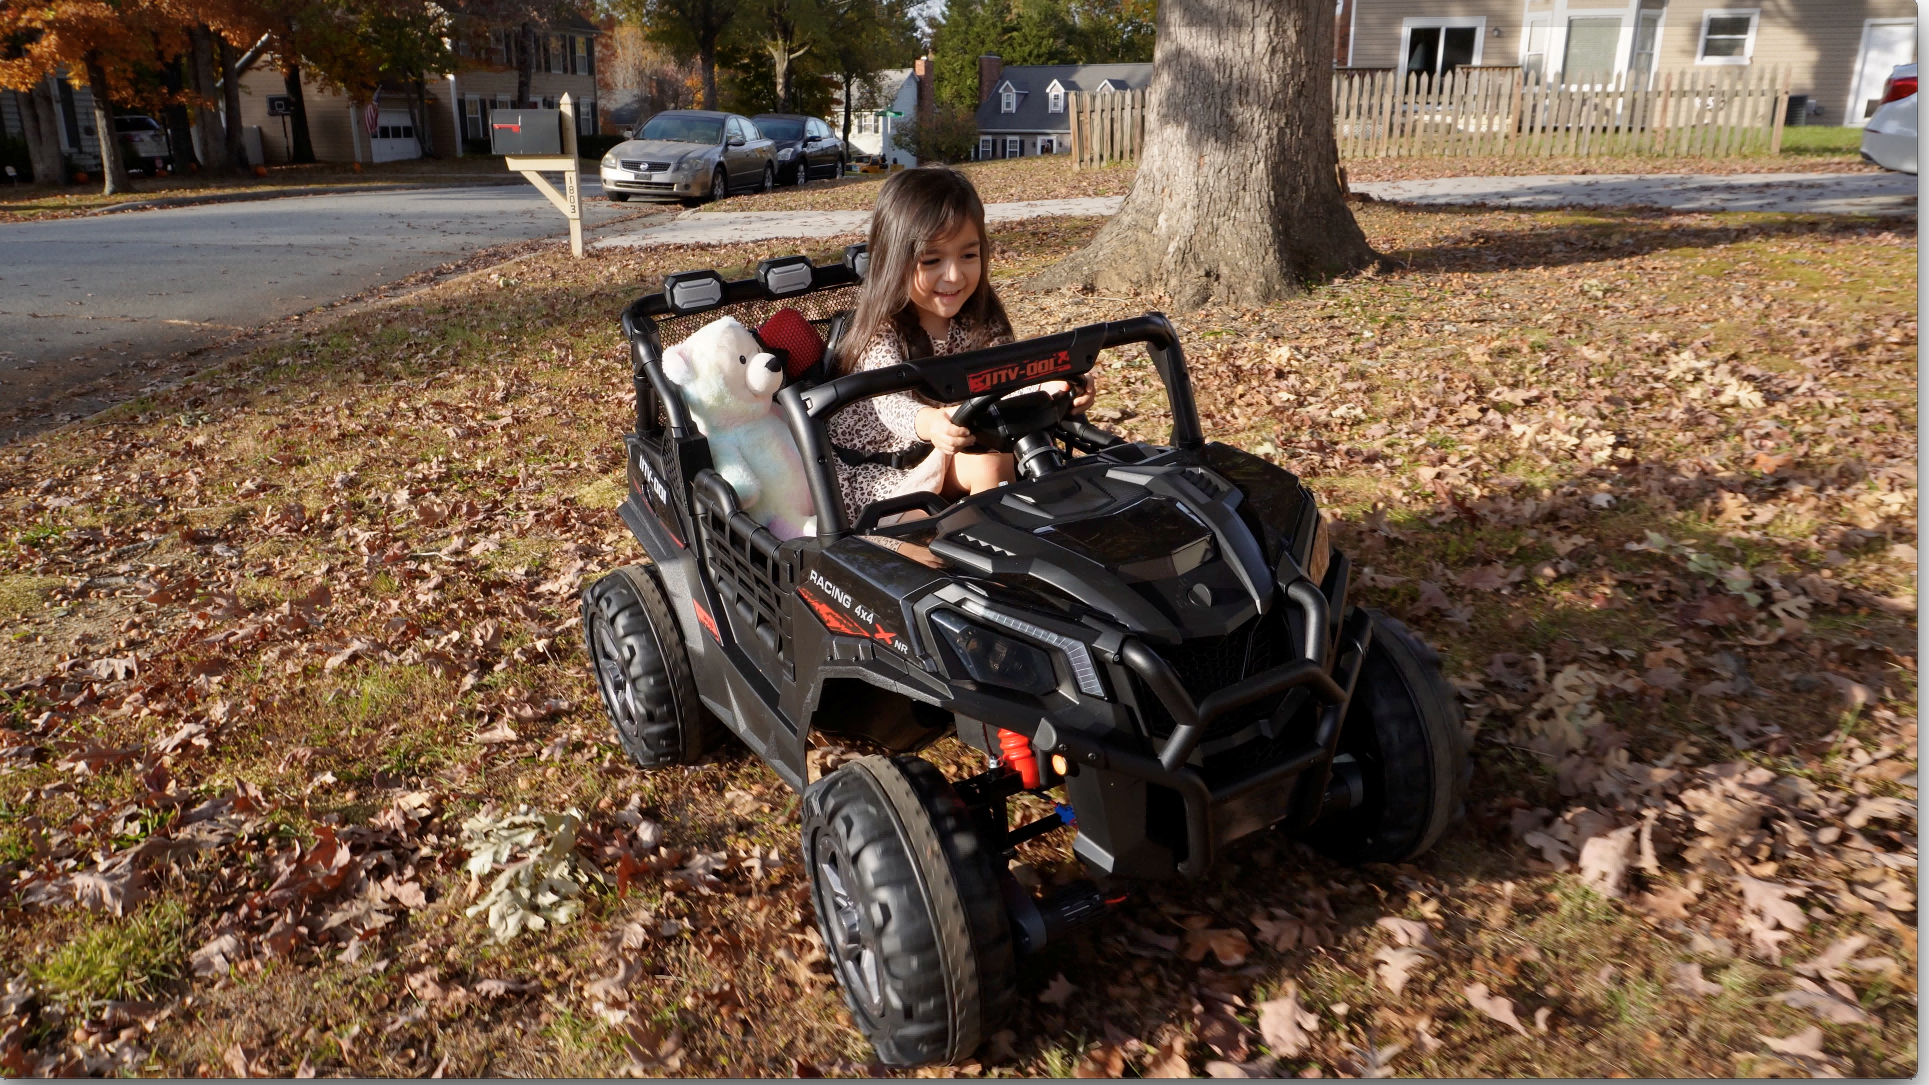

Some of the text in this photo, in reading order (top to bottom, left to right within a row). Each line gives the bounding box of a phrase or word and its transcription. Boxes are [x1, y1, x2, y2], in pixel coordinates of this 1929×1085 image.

[568, 176, 577, 214] 1803
[809, 569, 852, 609] RACING
[894, 639, 909, 655] NR
